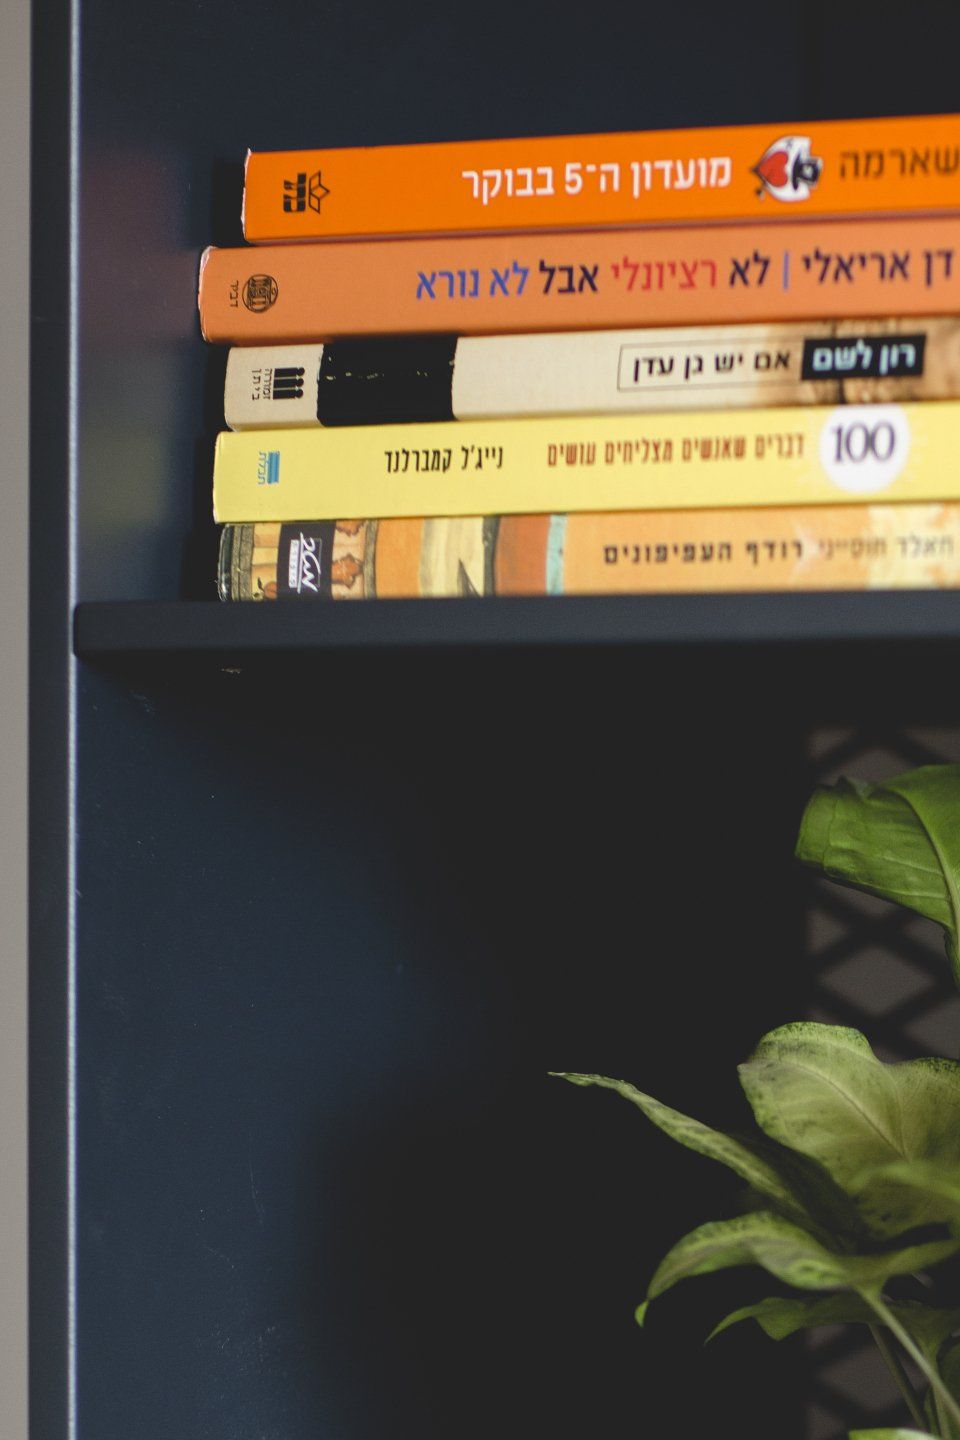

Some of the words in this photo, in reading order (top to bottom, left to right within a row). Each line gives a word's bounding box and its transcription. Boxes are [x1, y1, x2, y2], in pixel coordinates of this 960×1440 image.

[631, 157, 731, 199] מועדון
[839, 148, 960, 180] שארמה
[462, 167, 555, 204] בבוקר
[489, 261, 531, 297] לא
[539, 260, 599, 295] אבל
[610, 255, 717, 292] רציונלי
[729, 251, 770, 286] לא
[803, 249, 910, 284] אריאלי
[924, 249, 955, 286] דן
[415, 268, 480, 300] נורא
[633, 356, 674, 382] עדן
[684, 355, 703, 379] גן
[714, 353, 744, 374] יש
[753, 350, 790, 372] אם
[813, 339, 869, 371] לשם
[880, 342, 916, 375] רון
[547, 441, 597, 467] עושים
[605, 437, 673, 466] מצליחים
[682, 436, 746, 461] שאנשים
[755, 434, 805, 458] דברים
[832, 421, 895, 464] 100
[385, 447, 452, 475] קמברלנד
[603, 541, 731, 565] העפיפונים
[747, 539, 803, 564] רודף
